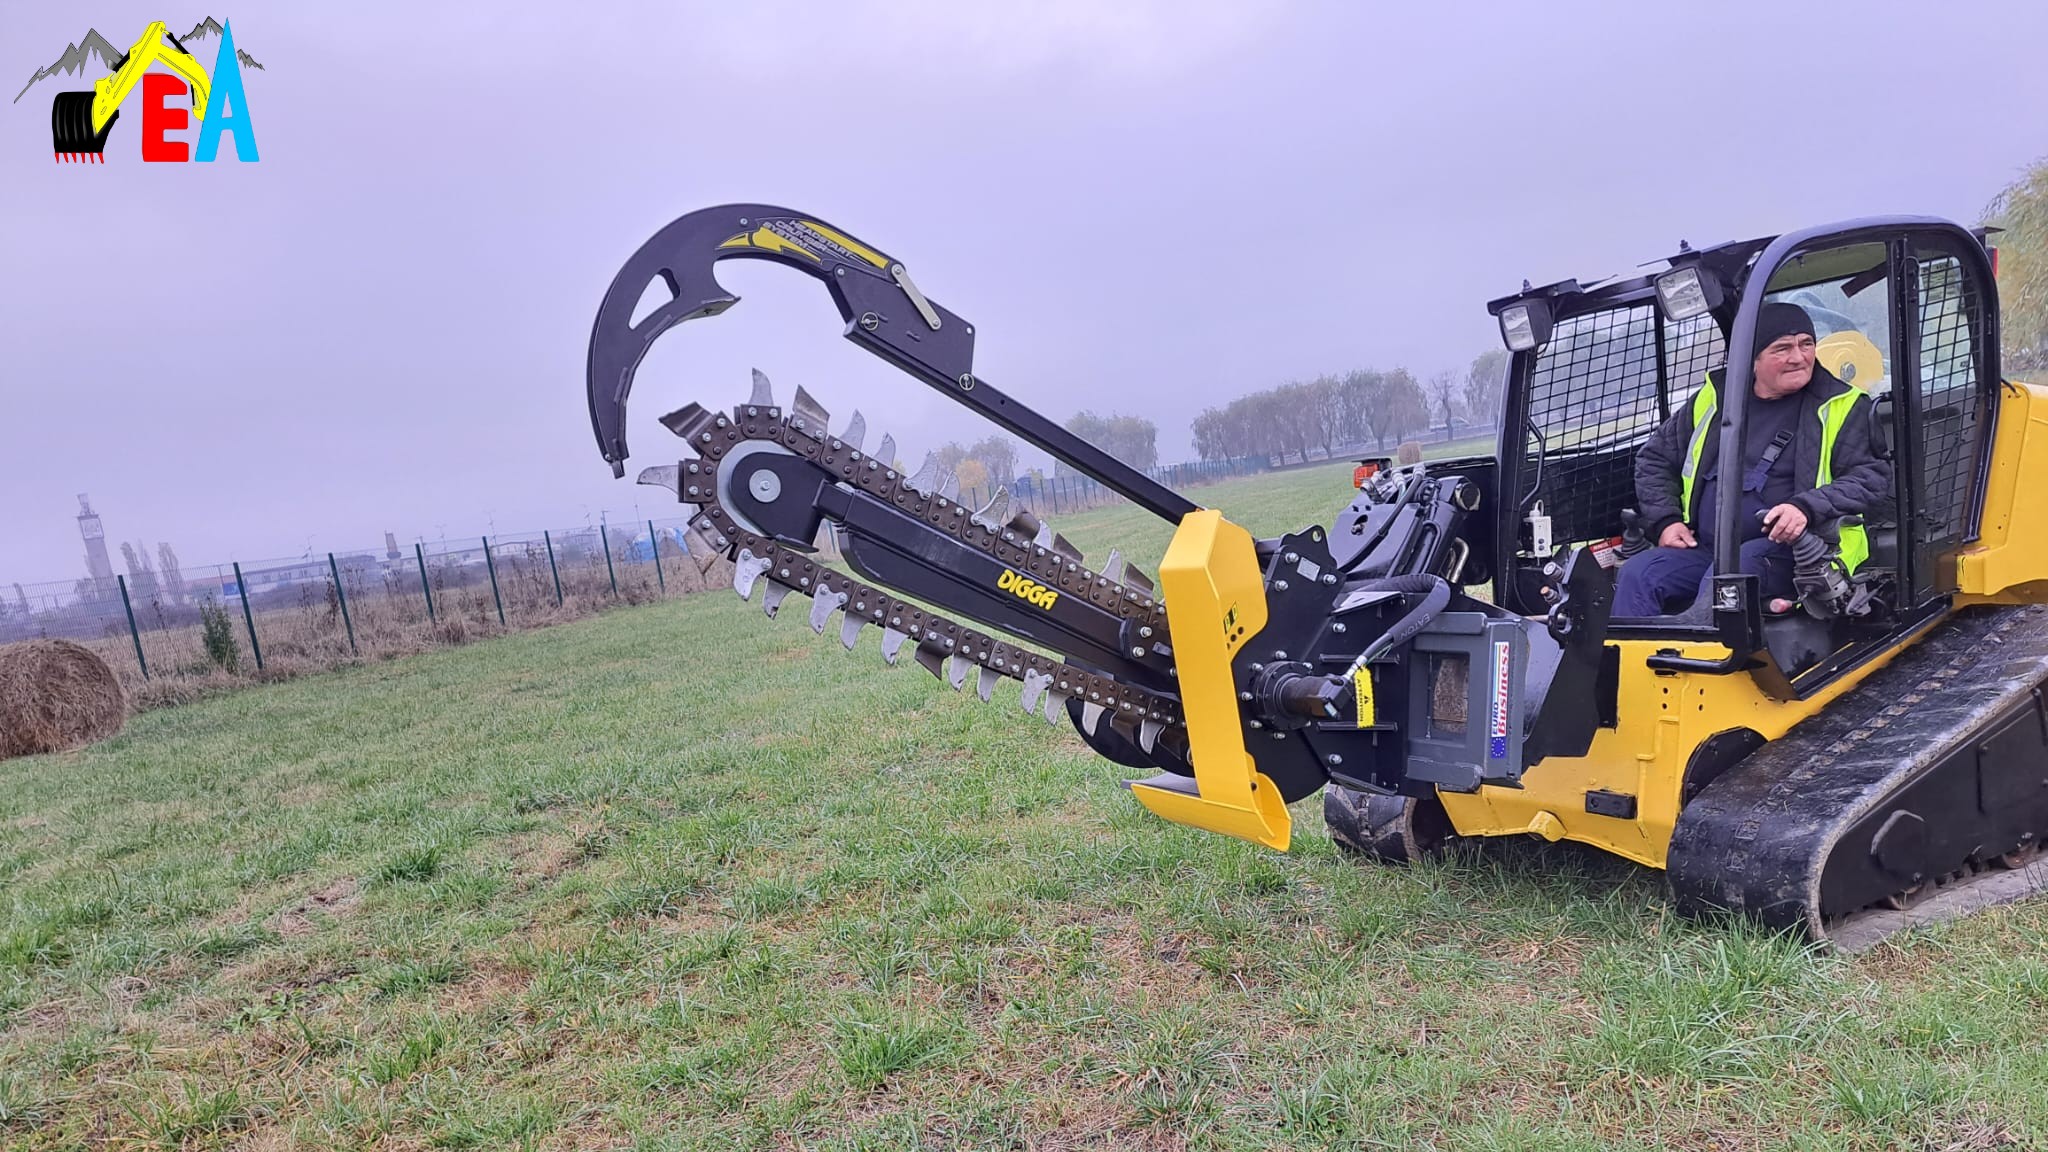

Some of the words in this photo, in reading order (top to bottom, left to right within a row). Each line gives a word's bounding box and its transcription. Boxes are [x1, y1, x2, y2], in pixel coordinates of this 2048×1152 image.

[762, 221, 808, 249] SYSTEM
[775, 220, 828, 252] CRUMBER
[789, 220, 852, 258] HEADSTART
[997, 569, 1059, 611] DIGGA
[1400, 613, 1431, 638] EATON
[1498, 645, 1508, 735] Business
